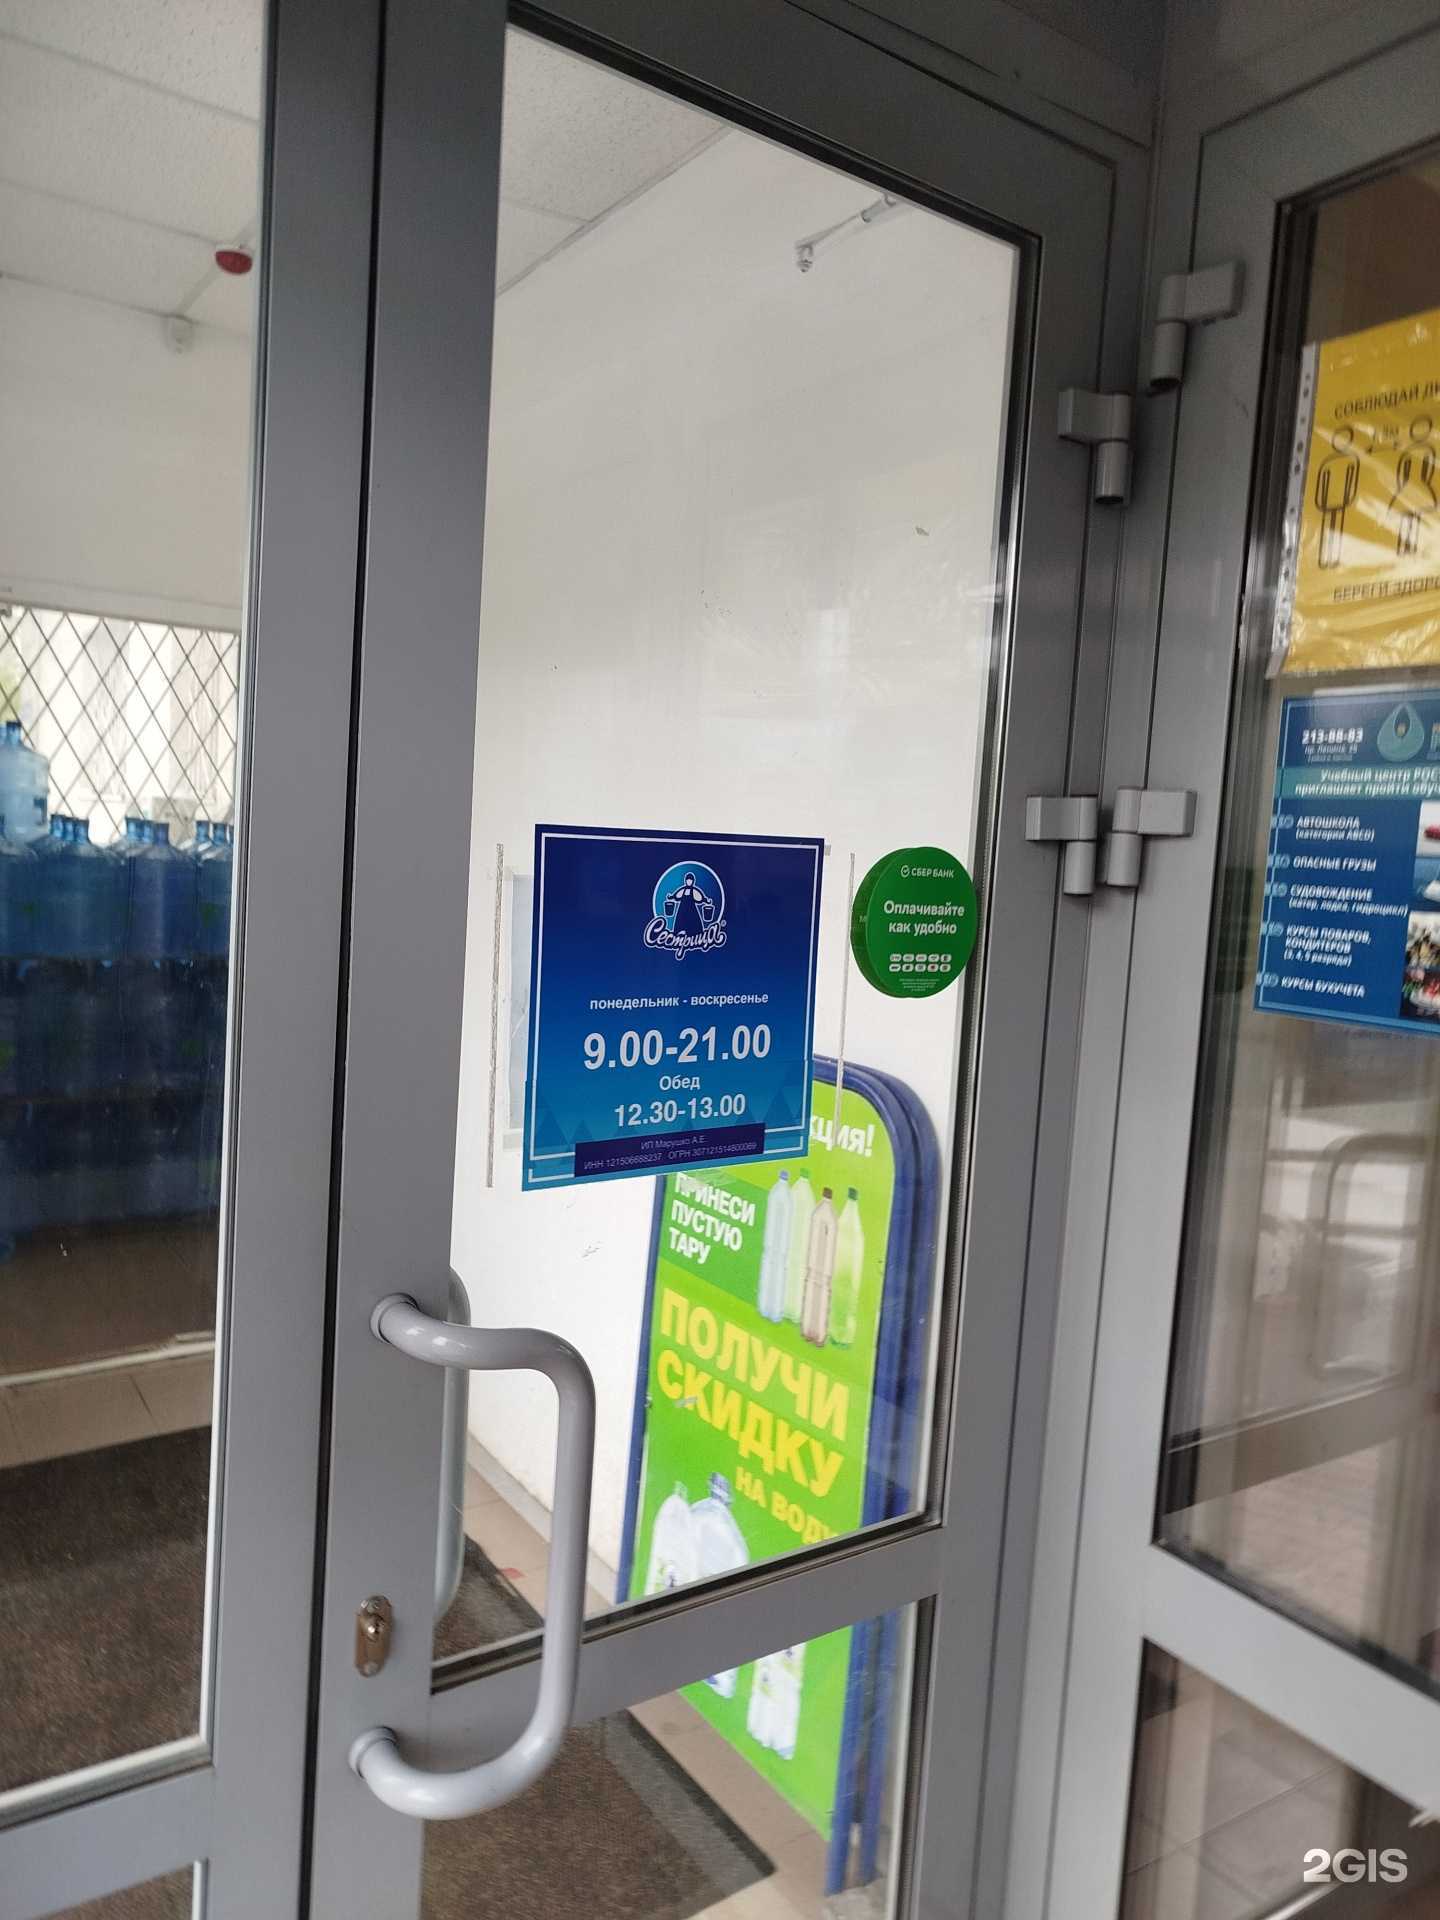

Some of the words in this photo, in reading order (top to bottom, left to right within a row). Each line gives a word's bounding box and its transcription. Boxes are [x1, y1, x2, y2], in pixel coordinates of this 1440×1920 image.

[1321, 768, 1372, 783] Учебный
[1374, 769, 1411, 783] центр
[1295, 784, 1362, 798] приглашает
[1364, 784, 1410, 798] пройти
[1296, 816, 1361, 830] АВТОШКОЛА
[1292, 855, 1341, 871] ОПАСНЫЕ
[1342, 858, 1377, 872] ГРУЗЫ
[1290, 884, 1373, 902] СУДОВОЖДЕНИЕ
[884, 900, 965, 917] Оплачивайте
[889, 922, 911, 933] как
[913, 920, 957, 936] удобно
[1286, 925, 1319, 939] КУРСЫ
[645, 917, 727, 958] Сестрица
[1285, 937, 1352, 954] КОНДИТЕРОВ
[1281, 976, 1314, 992] КУРСЫ
[590, 996, 680, 1010] понедельник
[690, 993, 769, 1007] воскресенье
[583, 1024, 771, 1070] 9.00-21.00
[659, 1075, 701, 1091] Обед
[614, 1093, 746, 1127] 12.30-13.00
[675, 1172, 756, 1227] ПРИНЕСИ
[671, 1199, 743, 1252] ПУСТУЮ
[669, 1226, 711, 1265] ТАРУ
[661, 1287, 849, 1443] ПОЛУЧИ
[656, 1348, 845, 1498] СКИДКУ
[735, 1466, 768, 1508] НА
[771, 1491, 841, 1545] ВОД
